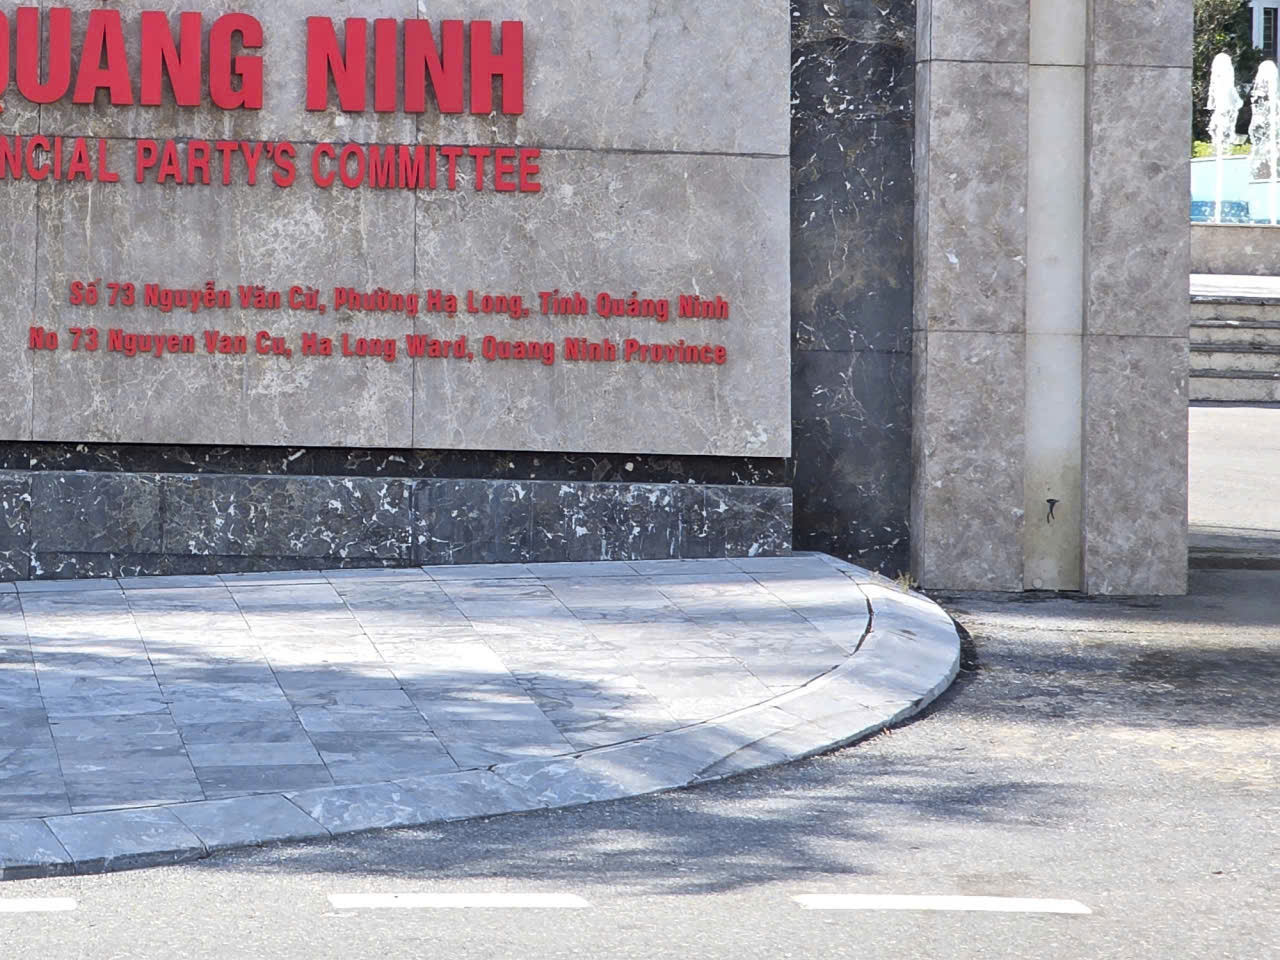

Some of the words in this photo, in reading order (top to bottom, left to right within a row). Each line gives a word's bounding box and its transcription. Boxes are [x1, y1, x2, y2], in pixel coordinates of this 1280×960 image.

[306, 15, 525, 116] NINH
[311, 141, 542, 193] COMMITTEE
[69, 278, 102, 306] Số
[107, 282, 136, 306] 73
[144, 280, 232, 313] Nguyễn
[237, 284, 281, 310] Văn
[287, 285, 326, 315] Cừ,
[333, 287, 419, 318] Phường
[426, 289, 458, 319] Hạ
[466, 290, 530, 320] Long,
[595, 290, 670, 323] Quảng
[677, 293, 729, 319] Ninh
[29, 325, 59, 352] No
[68, 327, 99, 352] 73
[107, 327, 196, 358] Nguyen
[204, 330, 248, 354] Van
[255, 330, 293, 360] Cu,
[301, 331, 333, 357] Ha
[341, 332, 397, 363] Long
[405, 333, 475, 362] Ward,
[481, 335, 556, 366] Quang
[564, 336, 617, 362] Ninh
[624, 338, 728, 366] Province
